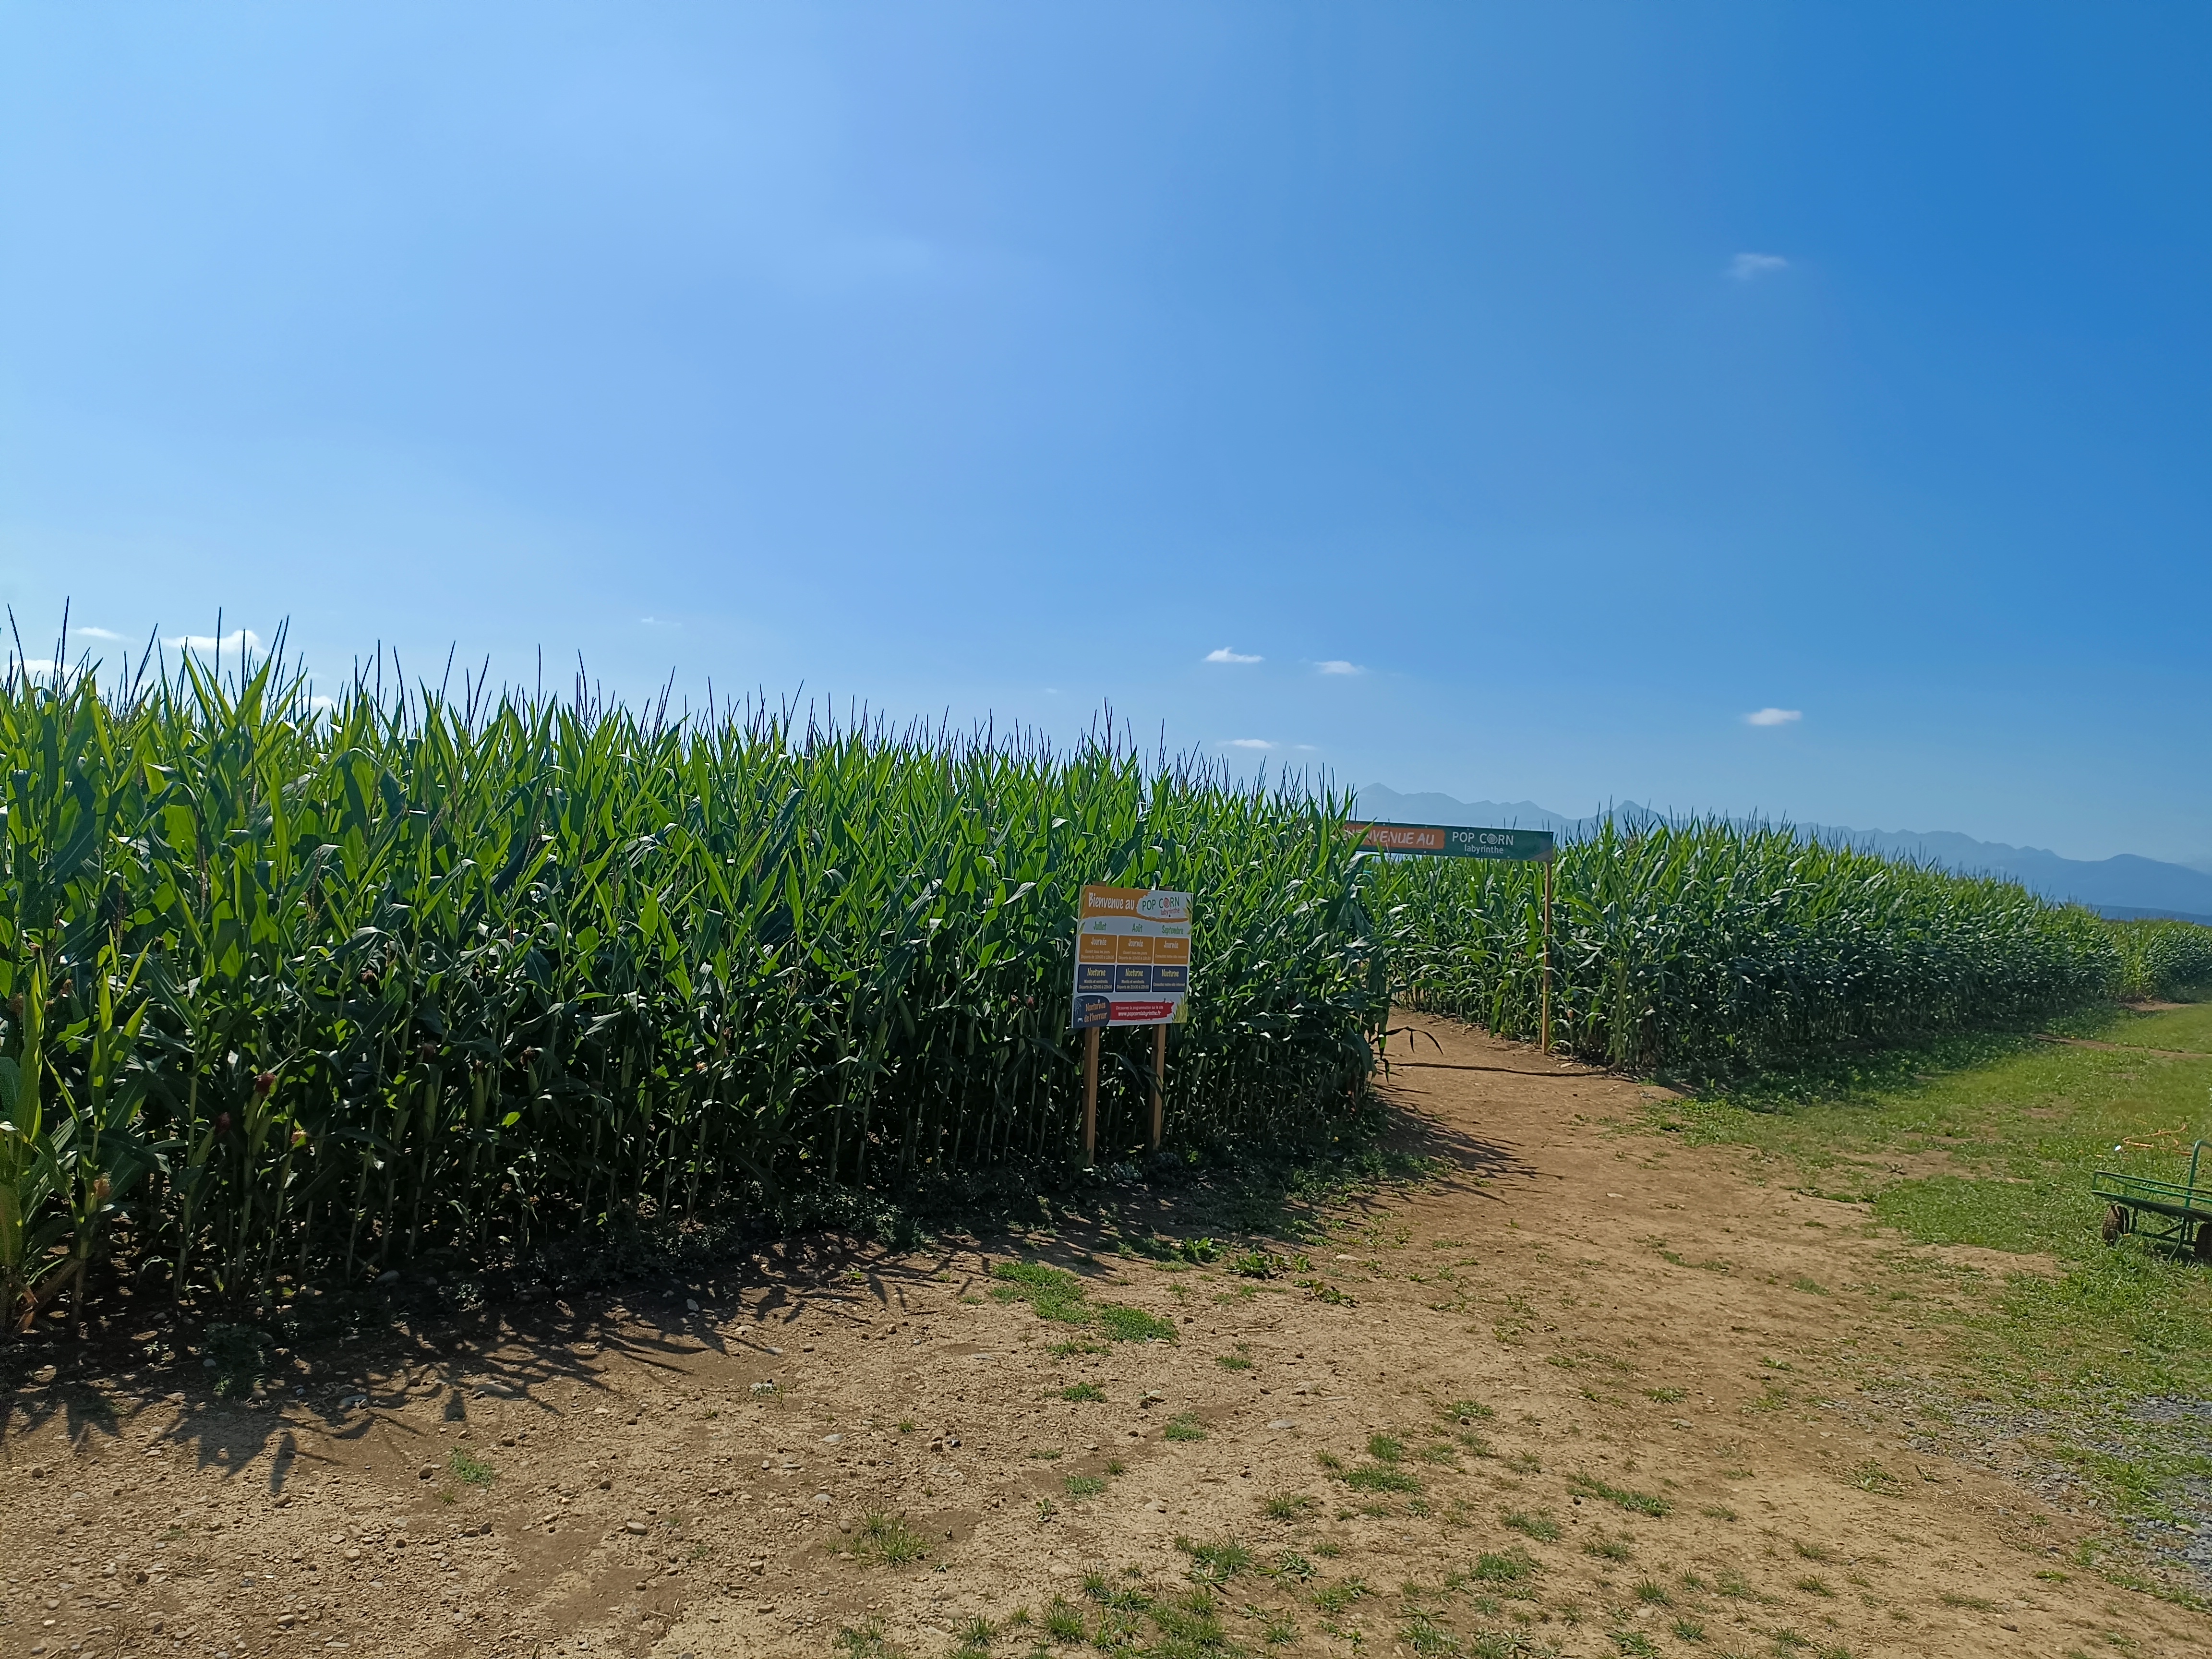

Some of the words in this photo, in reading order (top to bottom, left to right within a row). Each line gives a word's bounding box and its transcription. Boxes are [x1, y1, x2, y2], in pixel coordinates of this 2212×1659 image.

[1346, 829, 1414, 845] NVENUE
[1416, 833, 1434, 846] AU
[1452, 831, 1475, 843] POP
[1479, 833, 1514, 846] CORN
[1464, 844, 1504, 854] labyrinthe
[1088, 892, 1124, 909] Bienvenue
[1125, 899, 1135, 910] au
[1142, 899, 1156, 911] POP
[1159, 896, 1180, 909] CORN
[1160, 907, 1180, 915] labyrinthe
[1093, 921, 1106, 931] Juillet
[1132, 923, 1143, 933] Août
[1161, 925, 1184, 936] Septembre
[1091, 937, 1107, 946] Journée
[1128, 938, 1143, 947] Journée
[1164, 940, 1178, 949] Journée
[1087, 967, 1106, 976] Nocturne
[1125, 968, 1143, 977] Nocturne
[1161, 968, 1179, 977] Nocturne
[1085, 1002, 1106, 1012] Nocturnes
[1084, 1014, 1089, 1022] de
